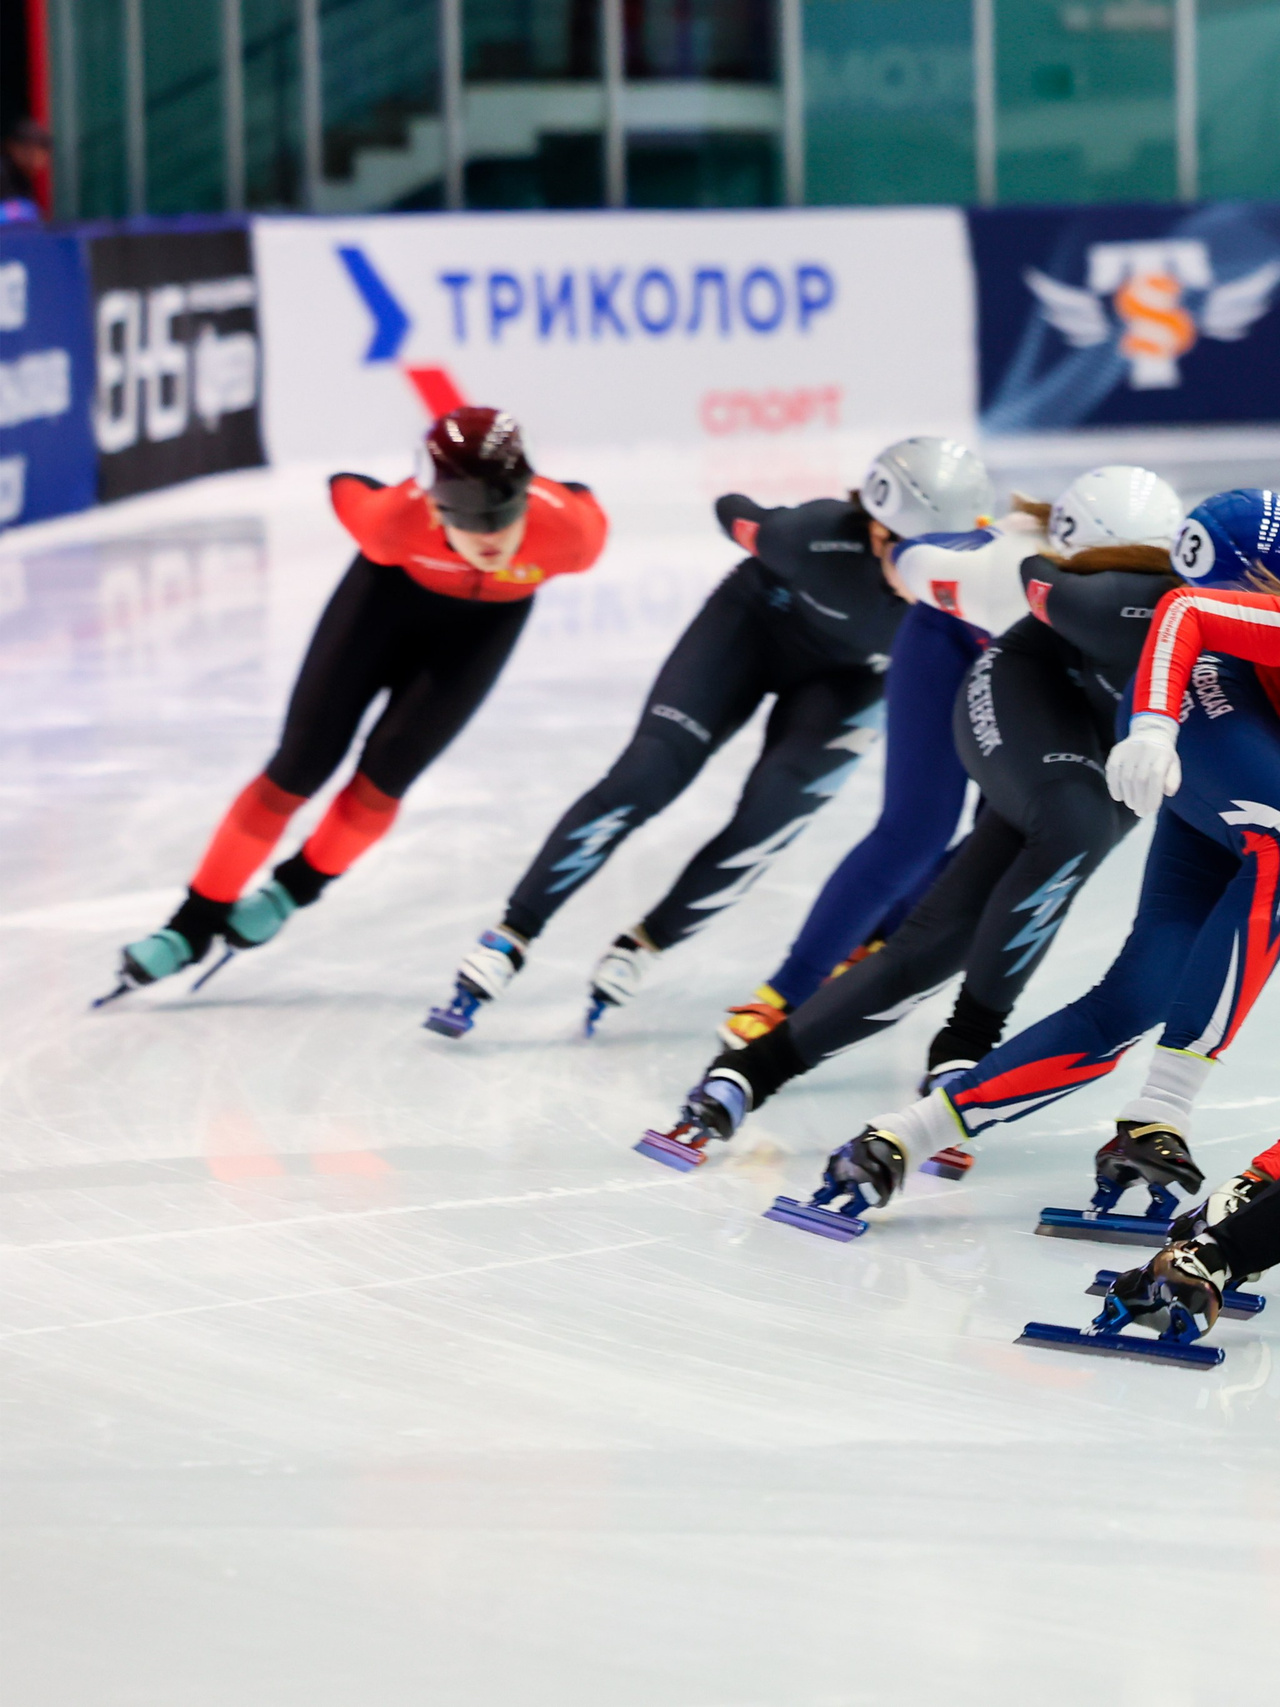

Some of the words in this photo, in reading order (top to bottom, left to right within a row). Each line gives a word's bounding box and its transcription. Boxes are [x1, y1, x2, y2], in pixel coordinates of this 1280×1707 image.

[438, 261, 837, 343] ТРИКОЛОР
[700, 385, 842, 434] СПОРТ
[1175, 526, 1201, 568] 13
